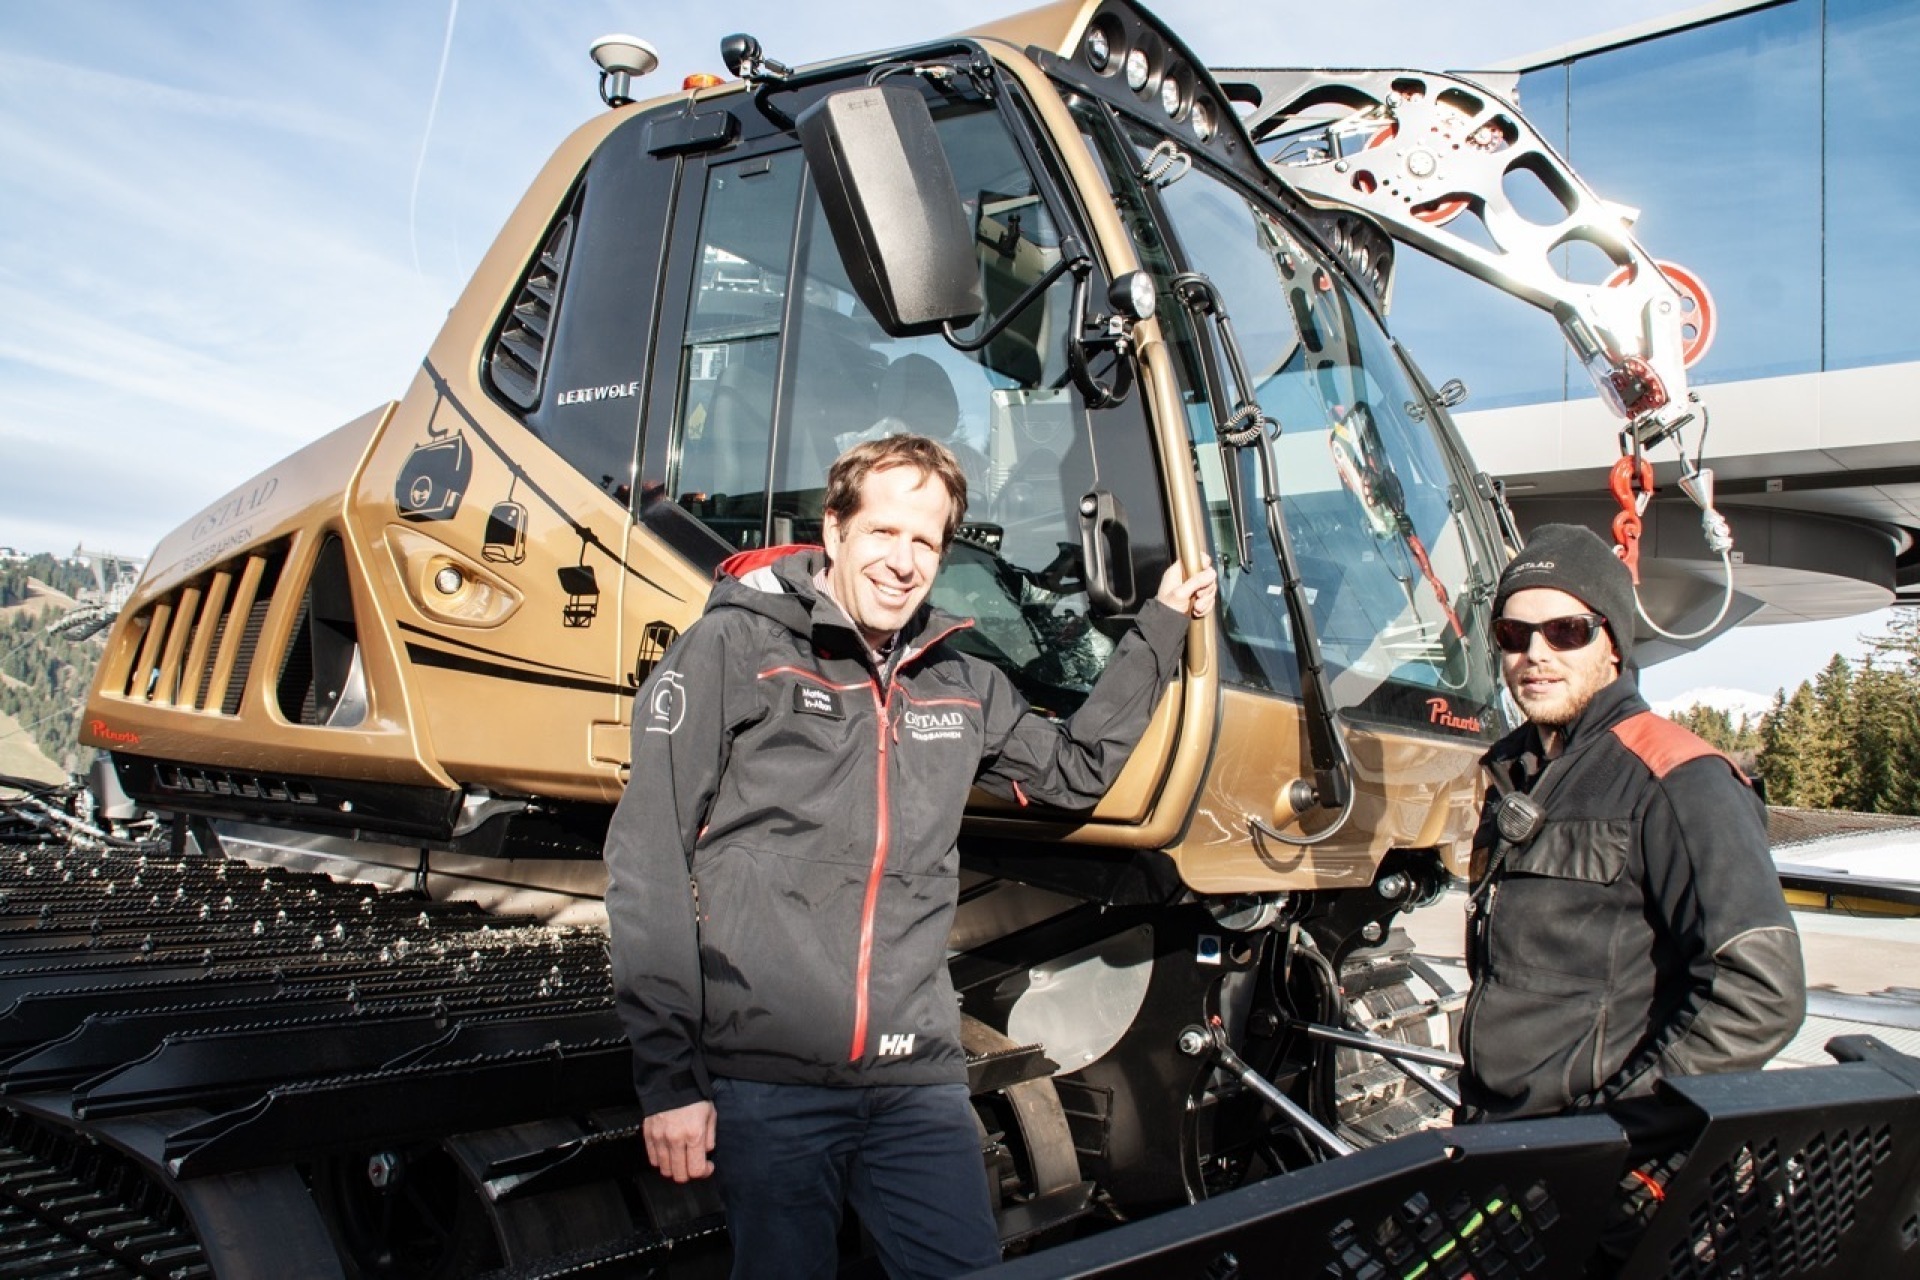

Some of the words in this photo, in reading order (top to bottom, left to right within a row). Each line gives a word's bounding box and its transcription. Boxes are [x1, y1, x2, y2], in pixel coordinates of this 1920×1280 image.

[1425, 697, 1481, 733] Prinoth
[89, 719, 140, 743] Prinoth
[878, 1033, 916, 1056] HH
